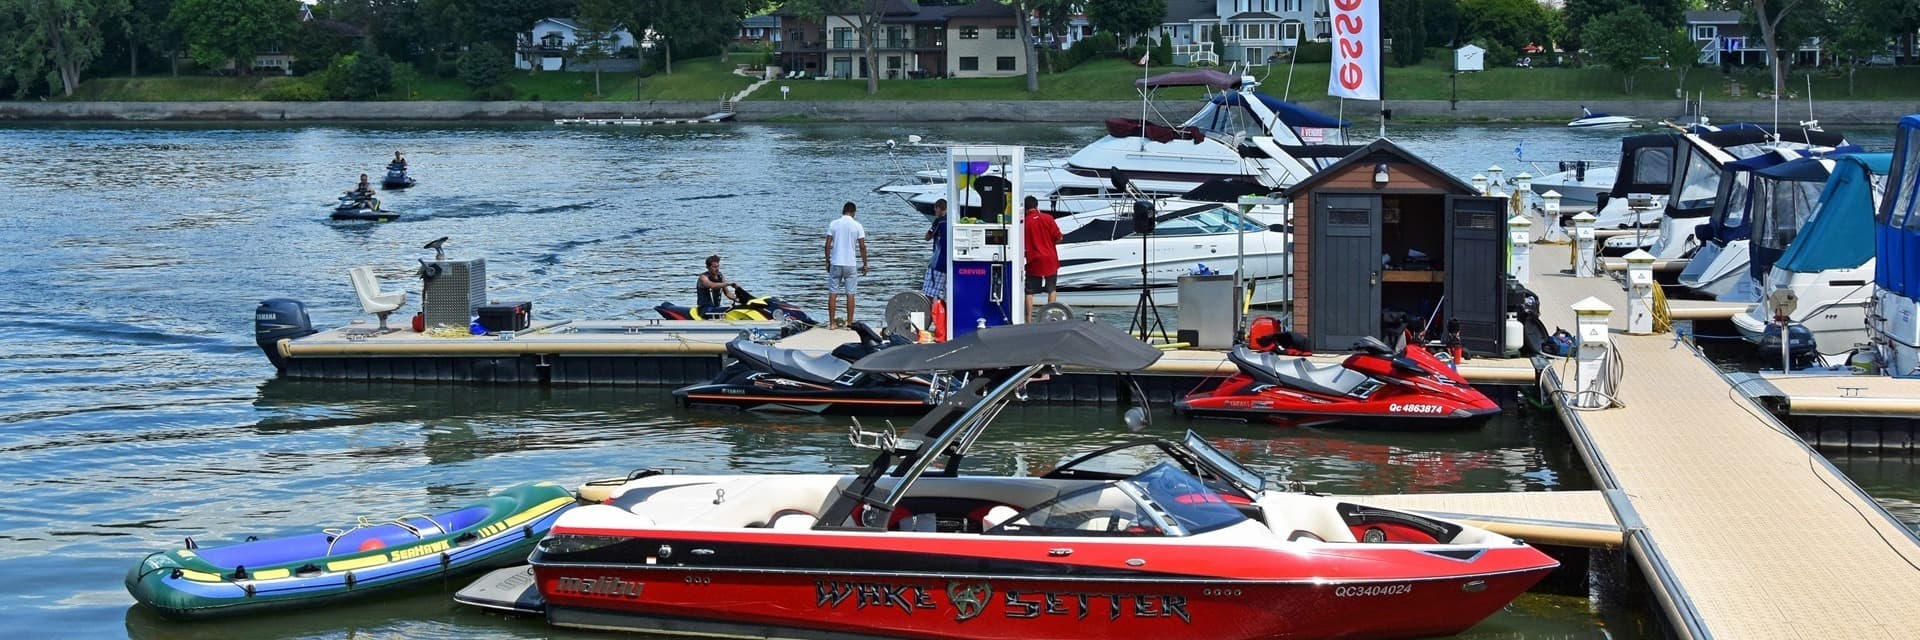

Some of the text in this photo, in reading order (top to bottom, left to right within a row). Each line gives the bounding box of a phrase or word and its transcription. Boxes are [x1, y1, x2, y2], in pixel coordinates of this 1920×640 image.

[958, 268, 986, 276] CREVIER
[1389, 403, 1443, 413] Qc 4863874
[557, 576, 645, 597] malibu
[1336, 584, 1412, 596] QC3404024
[815, 579, 1191, 624] WAKE SETTER
